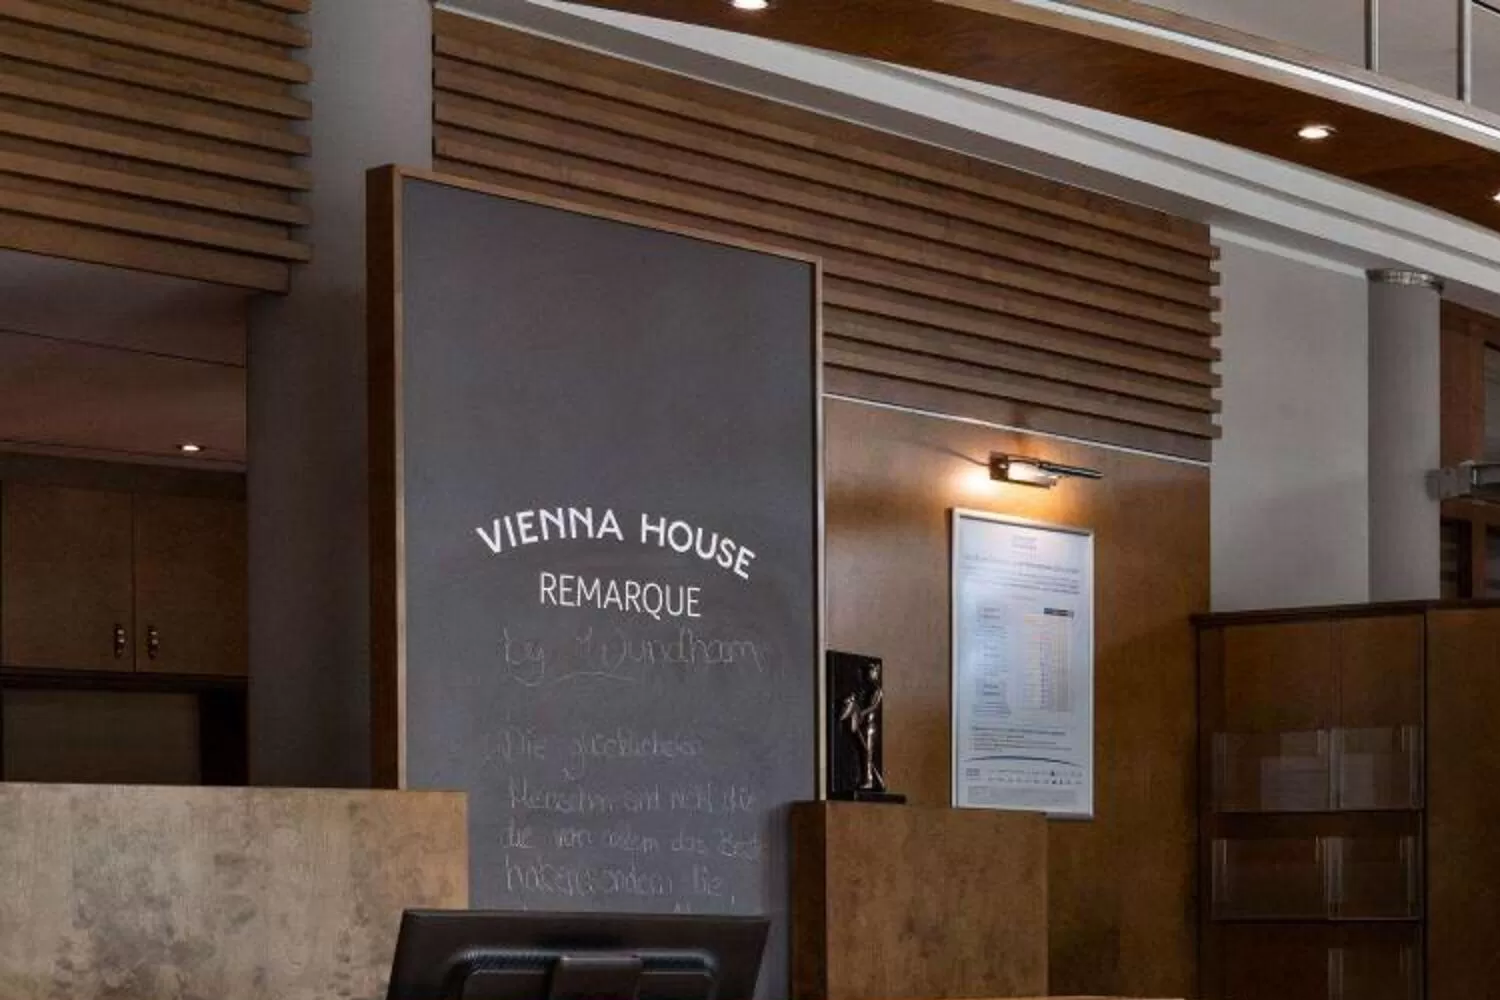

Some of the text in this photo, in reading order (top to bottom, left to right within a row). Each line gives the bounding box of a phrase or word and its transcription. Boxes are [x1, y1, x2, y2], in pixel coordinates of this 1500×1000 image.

[476, 507, 756, 580] VIENNA HOUSE
[539, 571, 701, 620] REMARQUE
